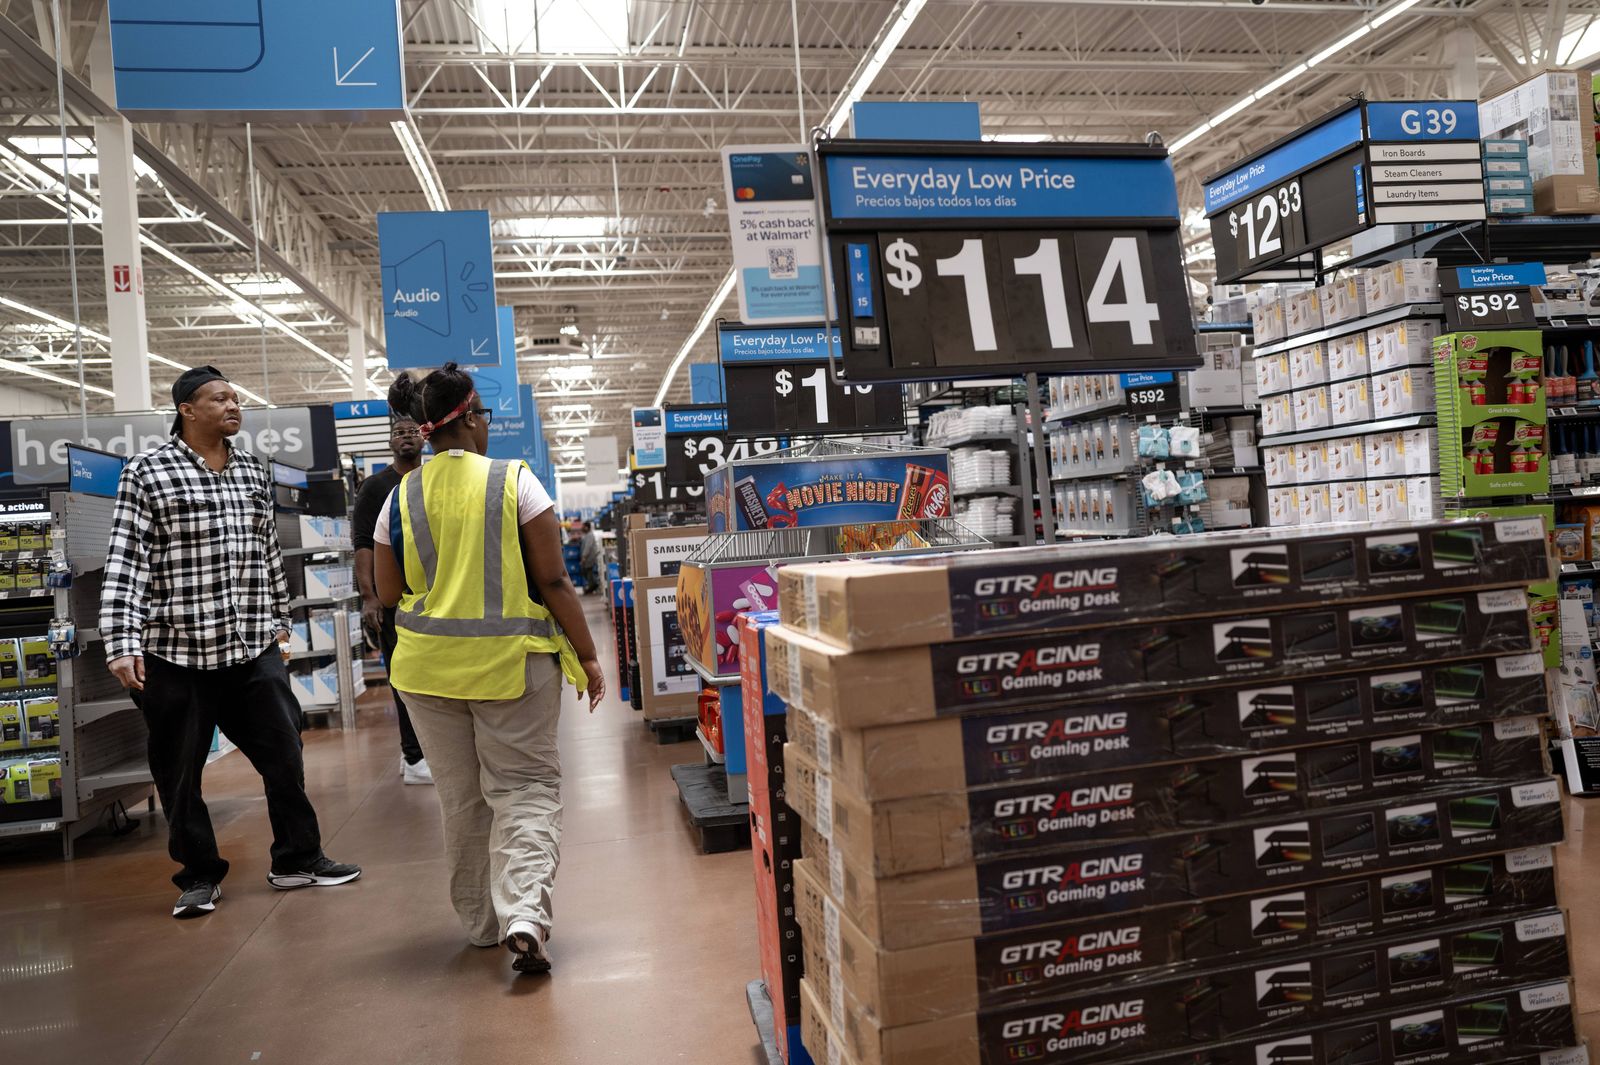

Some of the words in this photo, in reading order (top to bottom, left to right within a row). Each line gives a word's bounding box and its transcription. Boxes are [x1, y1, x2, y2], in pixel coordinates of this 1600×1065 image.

[732, 156, 761, 164] OnePay
[1382, 149, 1398, 158] Iron
[1400, 149, 1426, 157] Boards
[852, 167, 961, 195] Everyday
[968, 168, 1012, 190] Low
[1020, 168, 1076, 190] Price
[1384, 170, 1408, 178] Steam
[1409, 169, 1443, 177] Cleaners
[1209, 178, 1236, 199] Everyday
[1236, 173, 1249, 186] Low
[1249, 164, 1265, 178] Price
[1386, 190, 1417, 199] Laundry
[1418, 189, 1439, 198] Items
[855, 195, 901, 208] Precios
[904, 195, 936, 210] bajos
[938, 194, 971, 208] todos
[974, 194, 991, 207] los
[740, 219, 757, 230] 5%
[758, 219, 785, 229] cash
[787, 217, 815, 228] back
[746, 232, 758, 241] at
[854, 249, 862, 258] B
[856, 273, 865, 282] K
[1472, 274, 1490, 283] Low
[1491, 273, 1514, 281] Price
[393, 288, 440, 303] Audio
[858, 297, 868, 307] 15
[885, 237, 1160, 352] $114
[1458, 293, 1520, 317] $592
[394, 309, 418, 318] Audio
[733, 334, 787, 348] Everyday
[790, 333, 813, 345] Low
[734, 348, 756, 356] Precios
[757, 348, 774, 356] bajos
[774, 347, 791, 355] todos
[1127, 375, 1139, 383] Low
[1130, 389, 1166, 404] $592
[504, 420, 525, 430] Food
[673, 412, 712, 423] Everyday
[72, 465, 82, 477] Low
[82, 467, 92, 480] Price
[820, 473, 842, 482] MAKE
[786, 481, 844, 511] MOVIE
[845, 480, 900, 503] NIGHT
[7, 502, 44, 512] activate
[974, 568, 1118, 598] GTRACING
[981, 601, 1009, 619] LED
[1019, 596, 1080, 613] Gaming
[1083, 590, 1120, 607] Desk
[956, 643, 1100, 676] GTRACING
[963, 679, 991, 695] LED
[1001, 673, 1063, 691] Gaming
[1066, 667, 1103, 684] Desk
[986, 712, 1128, 744] GTRACING
[993, 749, 1021, 764] LED
[1030, 741, 1090, 760] Gaming
[1094, 735, 1130, 751] Desk
[994, 783, 1133, 817] GTRACING
[1520, 792, 1546, 801] Walmart
[1002, 822, 1028, 838] LED
[1037, 812, 1097, 832] Gaming
[1100, 806, 1135, 823] Desk
[1513, 858, 1539, 867] Walmart
[1002, 854, 1143, 890] GTRACING
[1010, 897, 1036, 912] LED
[1046, 885, 1106, 905] Gaming
[1110, 877, 1146, 895] Desk
[1524, 926, 1550, 936] Walmart
[1000, 926, 1141, 965] GTRACING
[1007, 970, 1034, 985] LED
[1043, 958, 1103, 979] Gaming
[1106, 949, 1142, 967] Desk
[1528, 996, 1555, 1005] Walmart
[1002, 999, 1144, 1039] GTRACING
[1009, 1042, 1036, 1057] LED
[1046, 1032, 1106, 1053] Gaming
[1110, 1023, 1146, 1041] Desk
